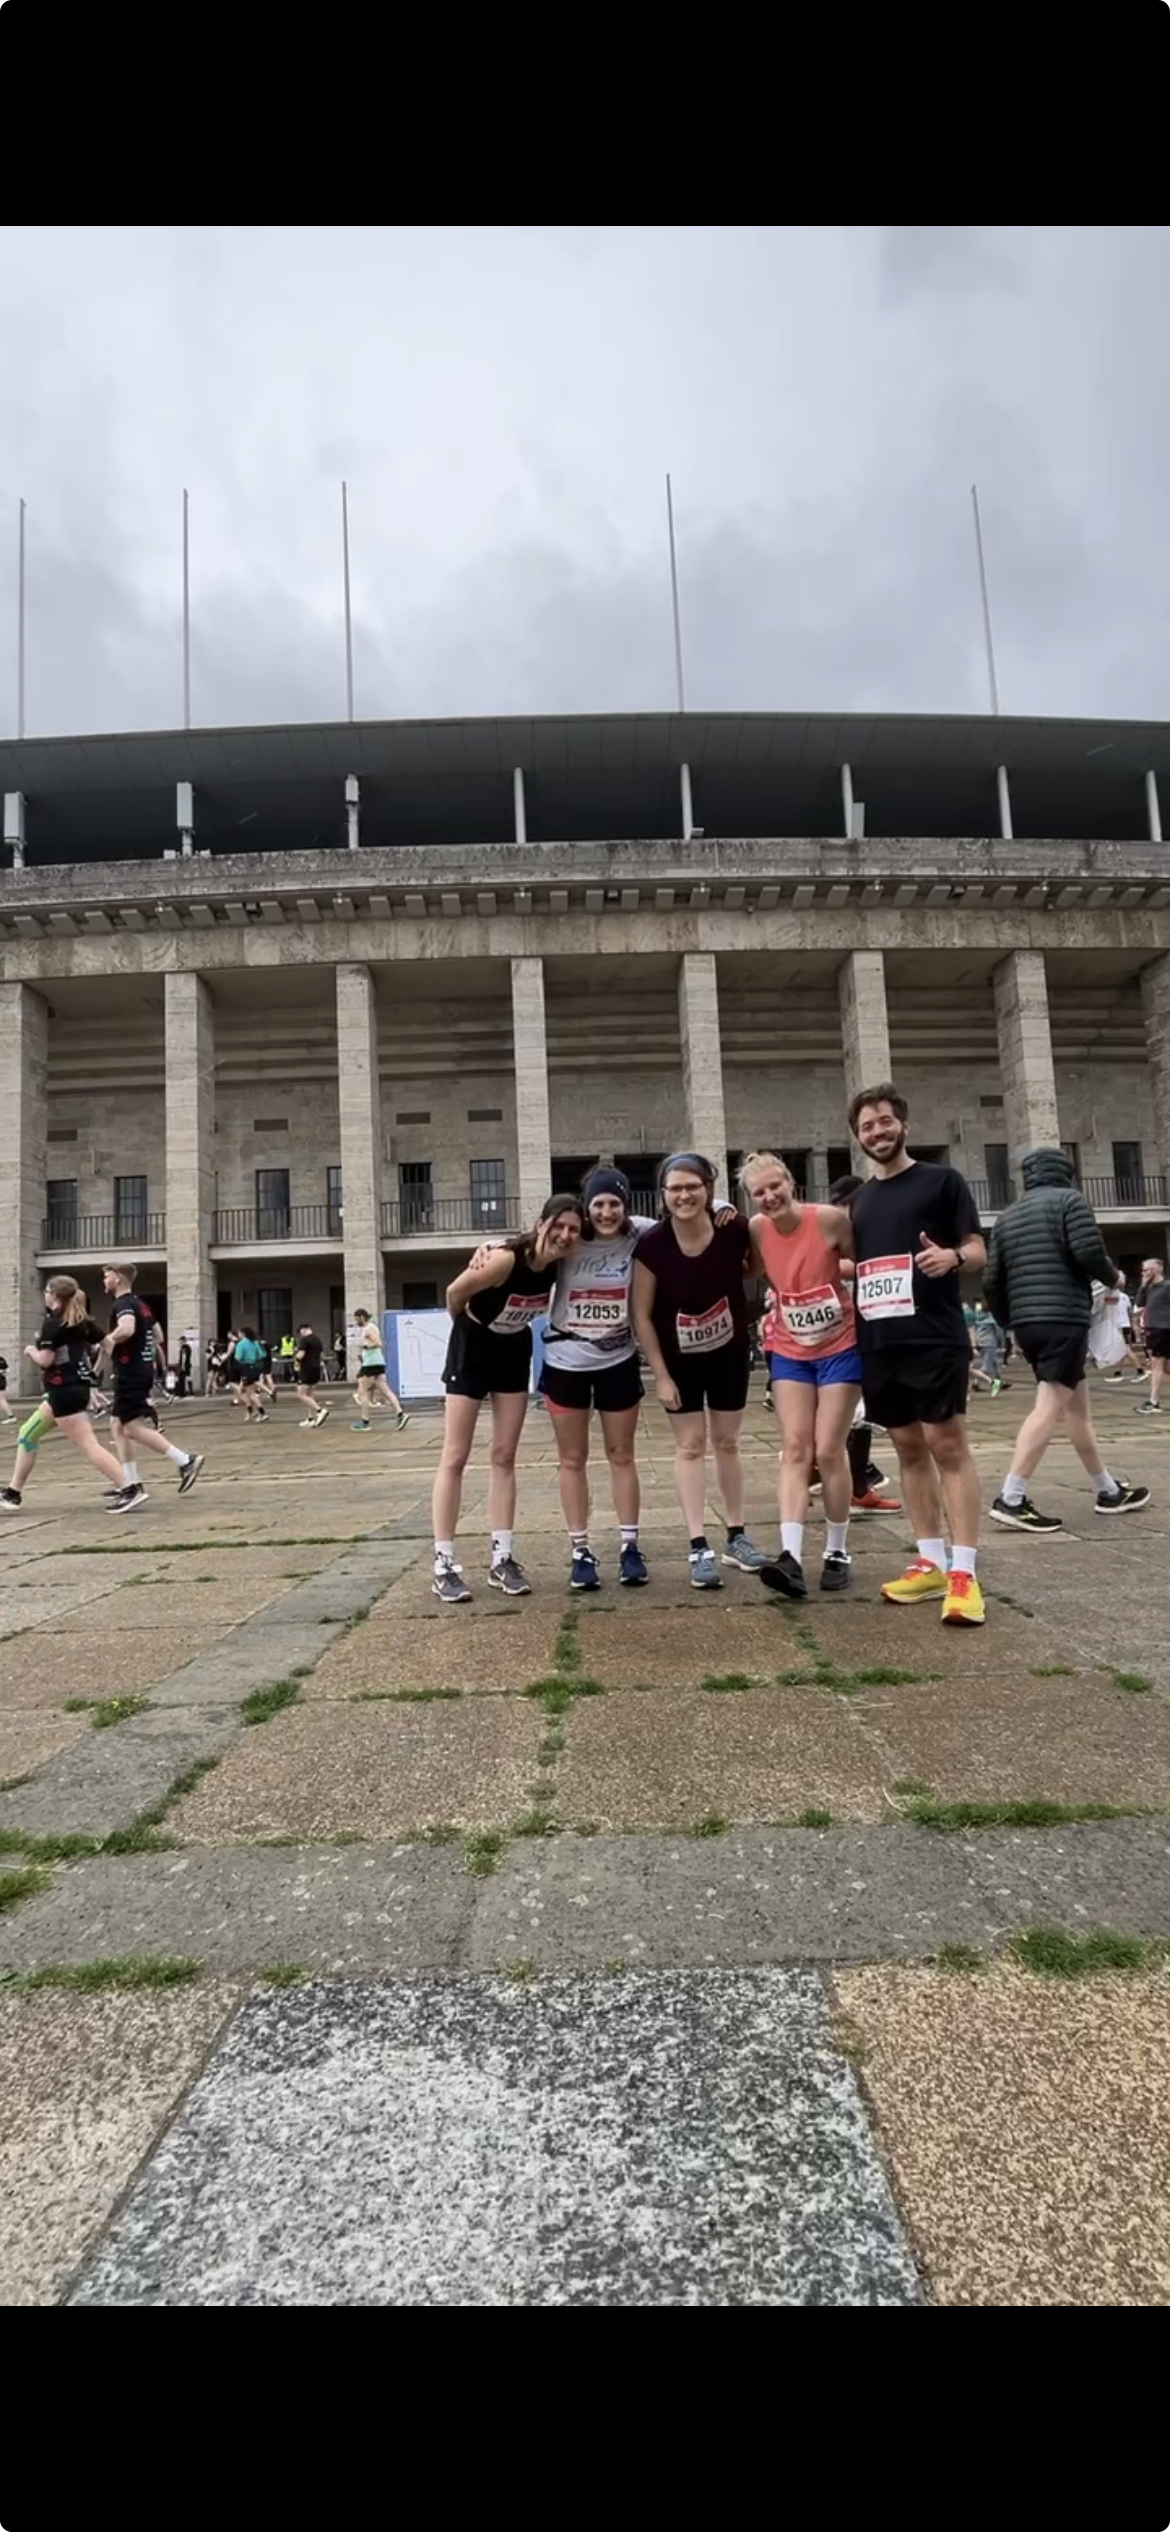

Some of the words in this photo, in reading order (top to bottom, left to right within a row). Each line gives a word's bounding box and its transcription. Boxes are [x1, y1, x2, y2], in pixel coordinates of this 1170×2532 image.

[862, 1277, 903, 1299] 12507
[575, 1304, 620, 1319] 12053
[788, 1305, 835, 1327] 12446
[685, 1317, 728, 1342] 10974
